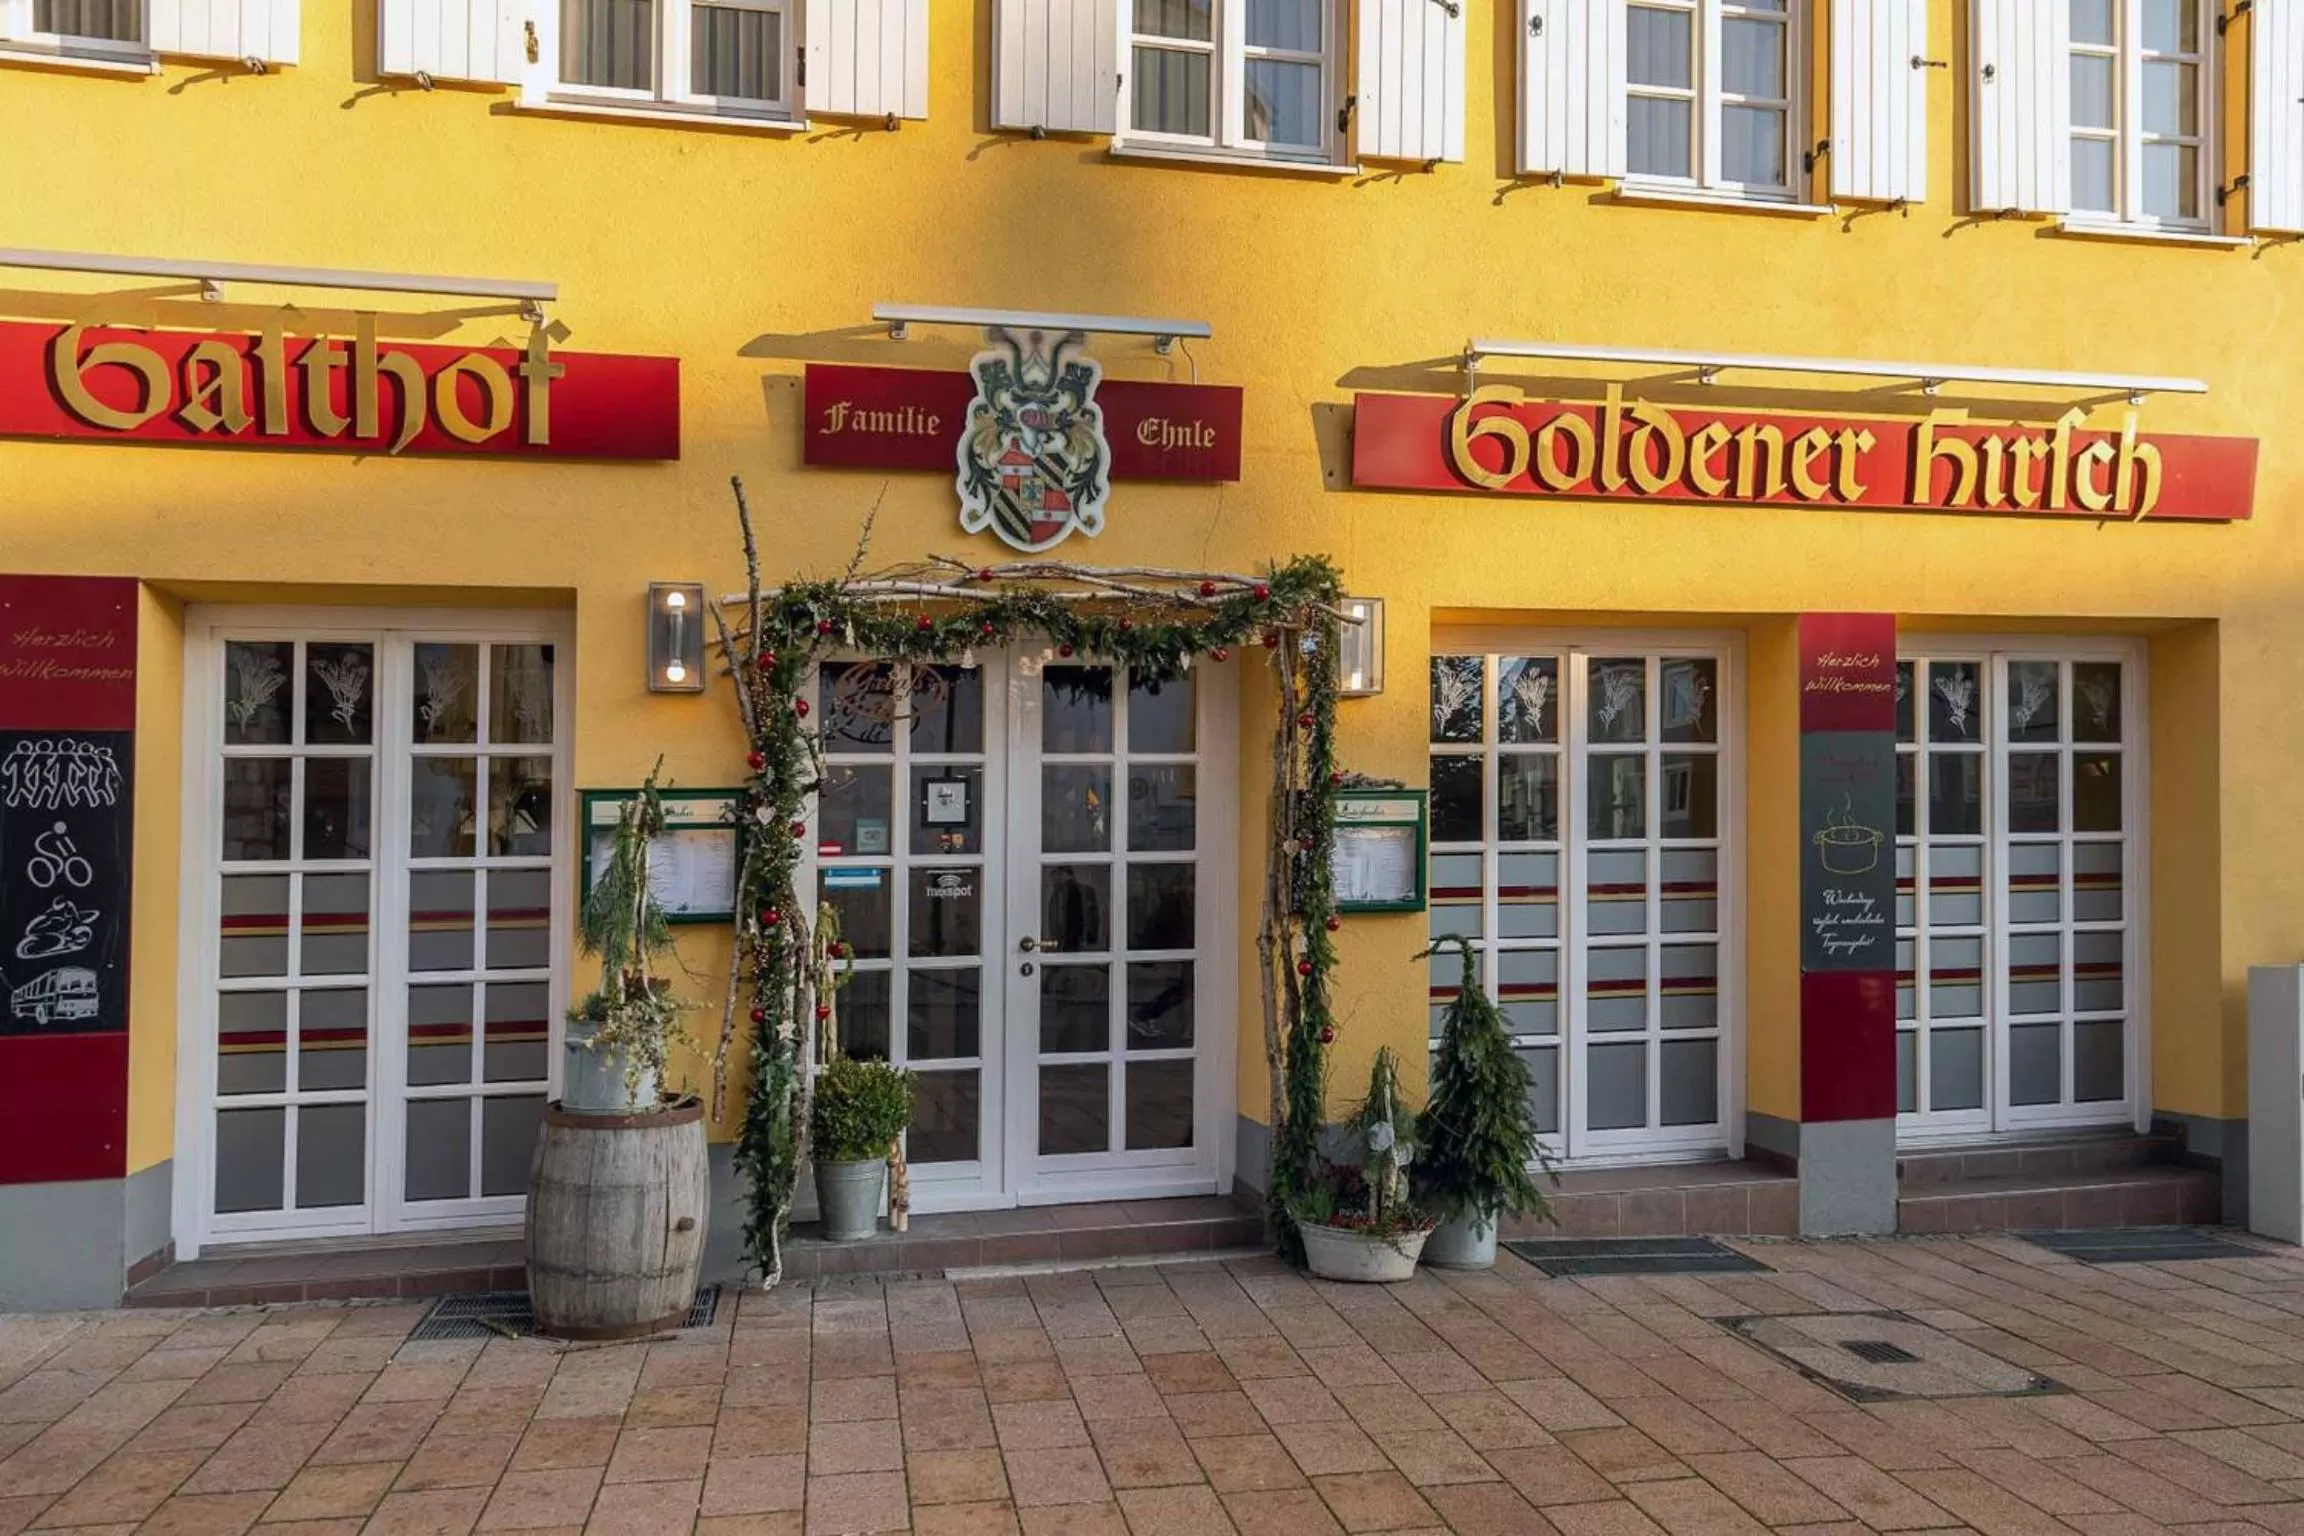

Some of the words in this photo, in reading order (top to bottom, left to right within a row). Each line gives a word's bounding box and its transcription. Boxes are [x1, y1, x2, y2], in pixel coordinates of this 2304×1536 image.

[819, 401, 941, 436] Familie
[1136, 417, 1216, 452] Ehnle
[1450, 383, 1877, 502] Goldener
[13, 627, 115, 648] Herzlich
[1816, 652, 1880, 668] Herzlich
